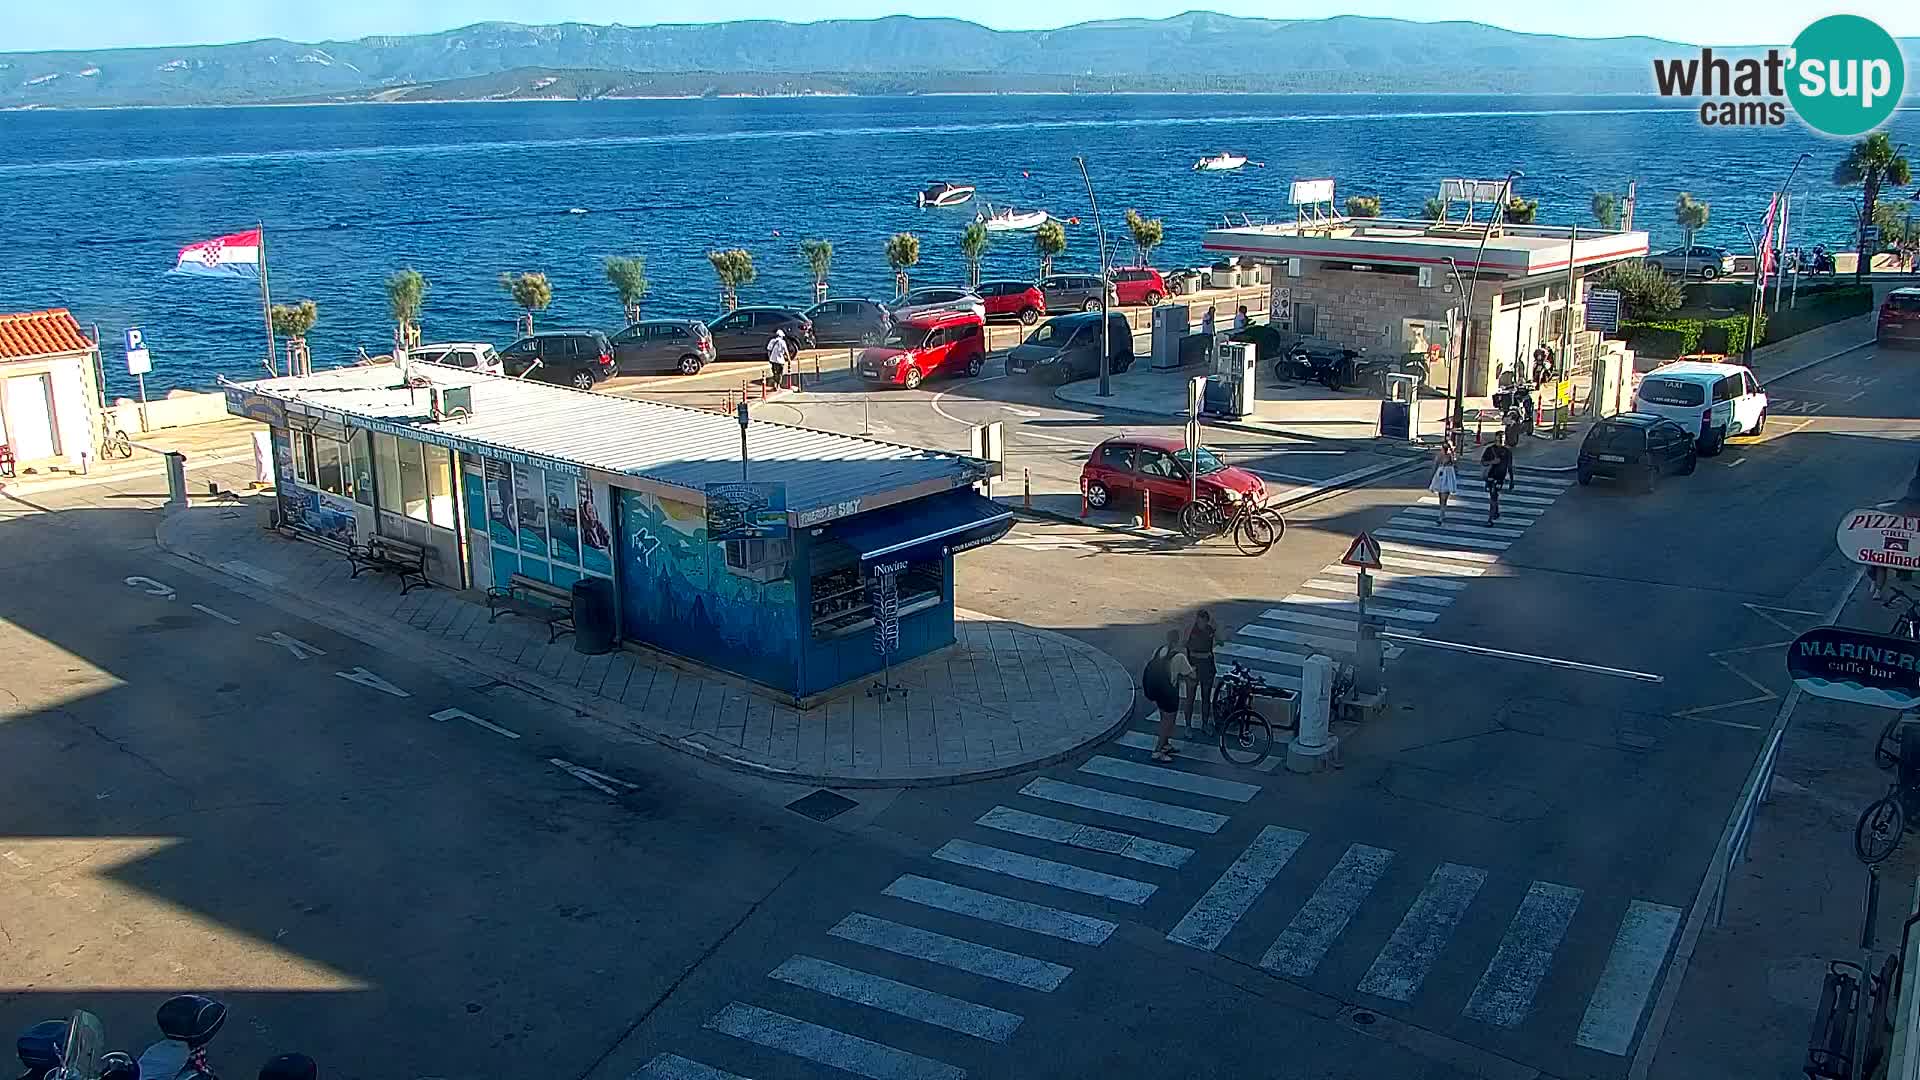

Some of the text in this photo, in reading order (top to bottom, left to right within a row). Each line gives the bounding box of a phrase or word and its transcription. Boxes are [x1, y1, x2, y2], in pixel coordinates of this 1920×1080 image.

[128, 330, 142, 349] P
[493, 448, 526, 464] STATION
[527, 456, 554, 470] TICKET
[555, 463, 582, 476] OFFICE
[1870, 664, 1896, 679] bar
